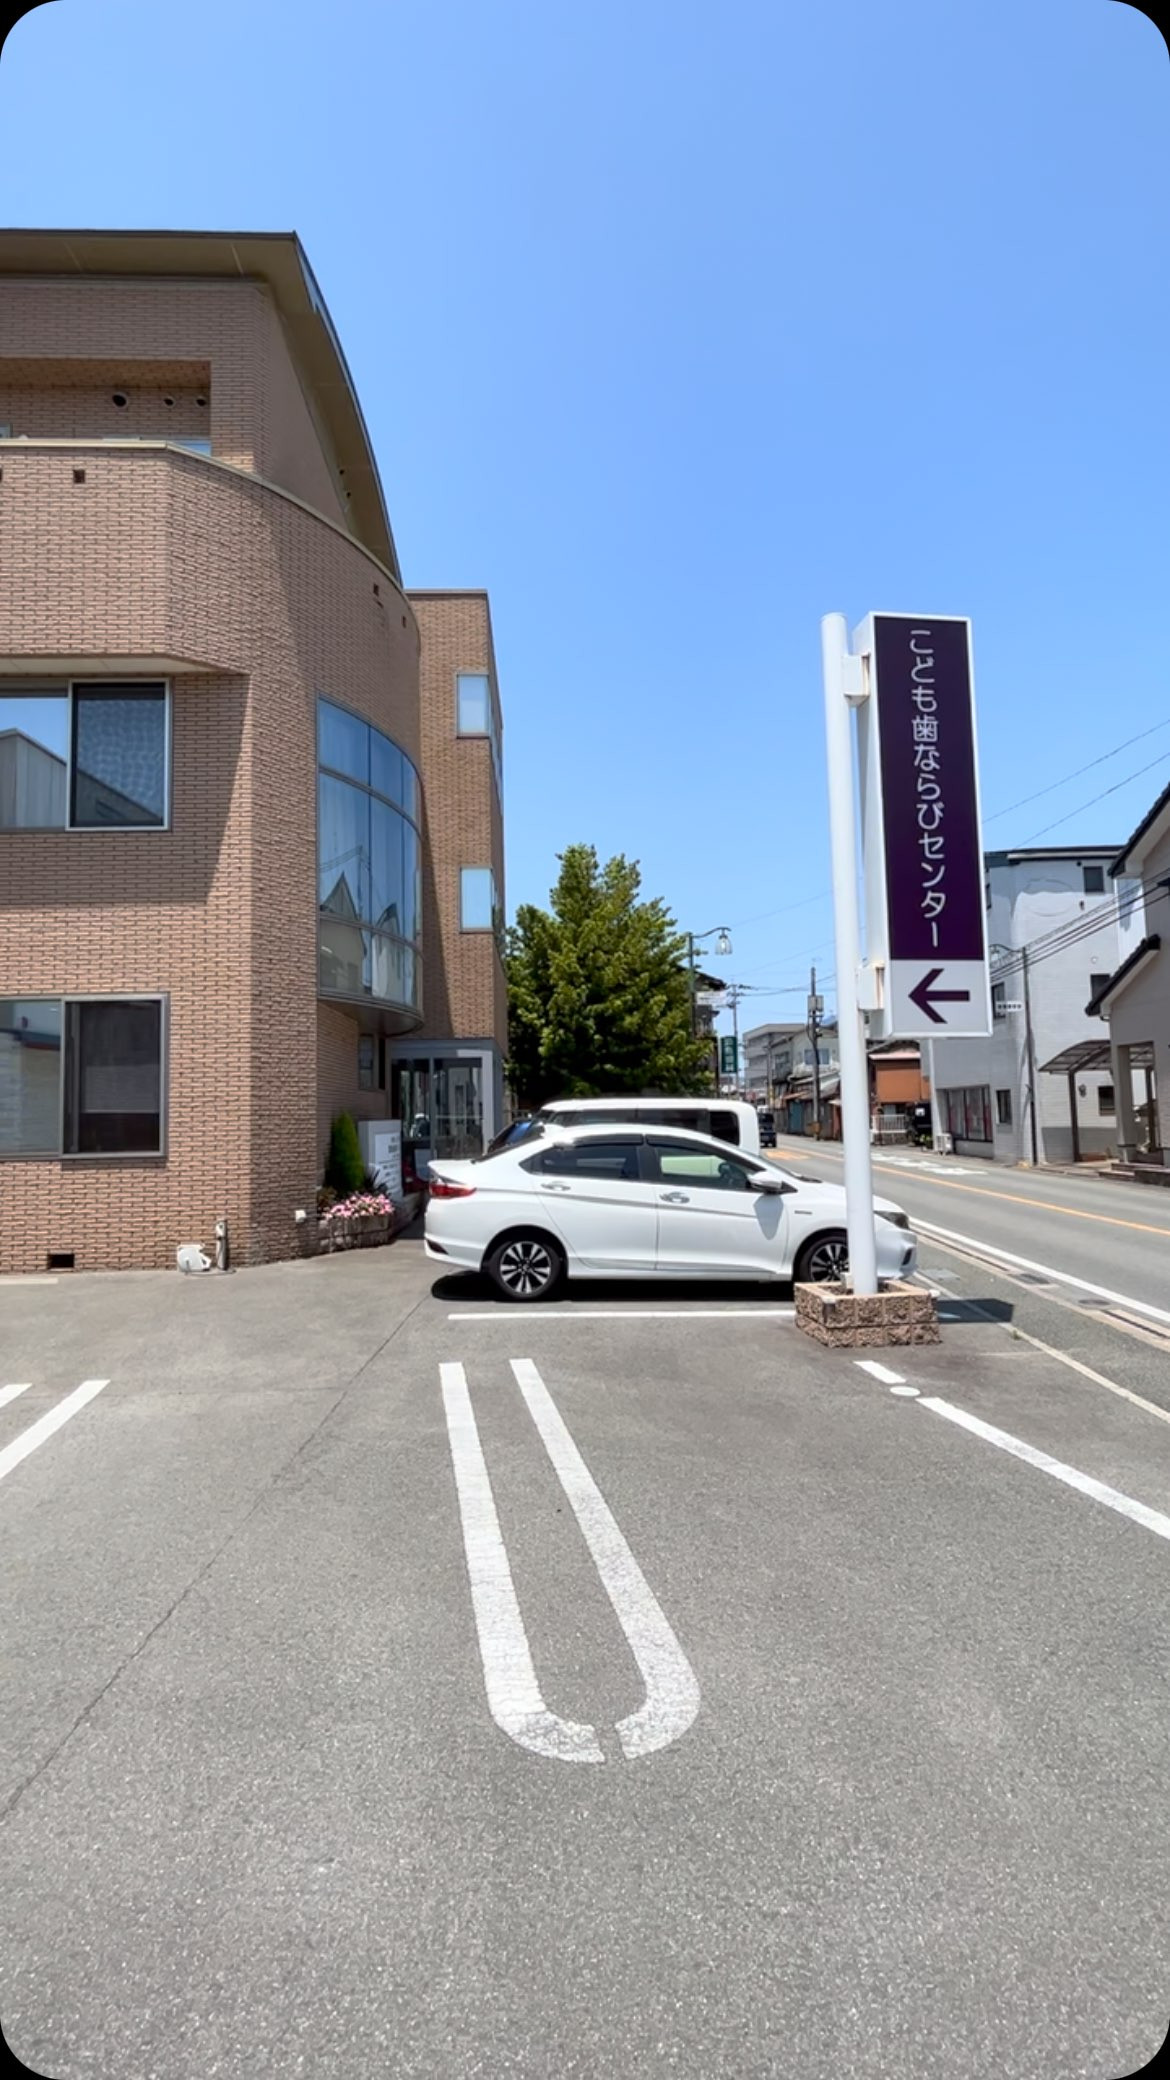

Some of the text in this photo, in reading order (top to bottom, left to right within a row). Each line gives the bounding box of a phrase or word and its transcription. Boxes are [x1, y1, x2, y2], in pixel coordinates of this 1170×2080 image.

[909, 629, 946, 948] こども歯ならびセンター
